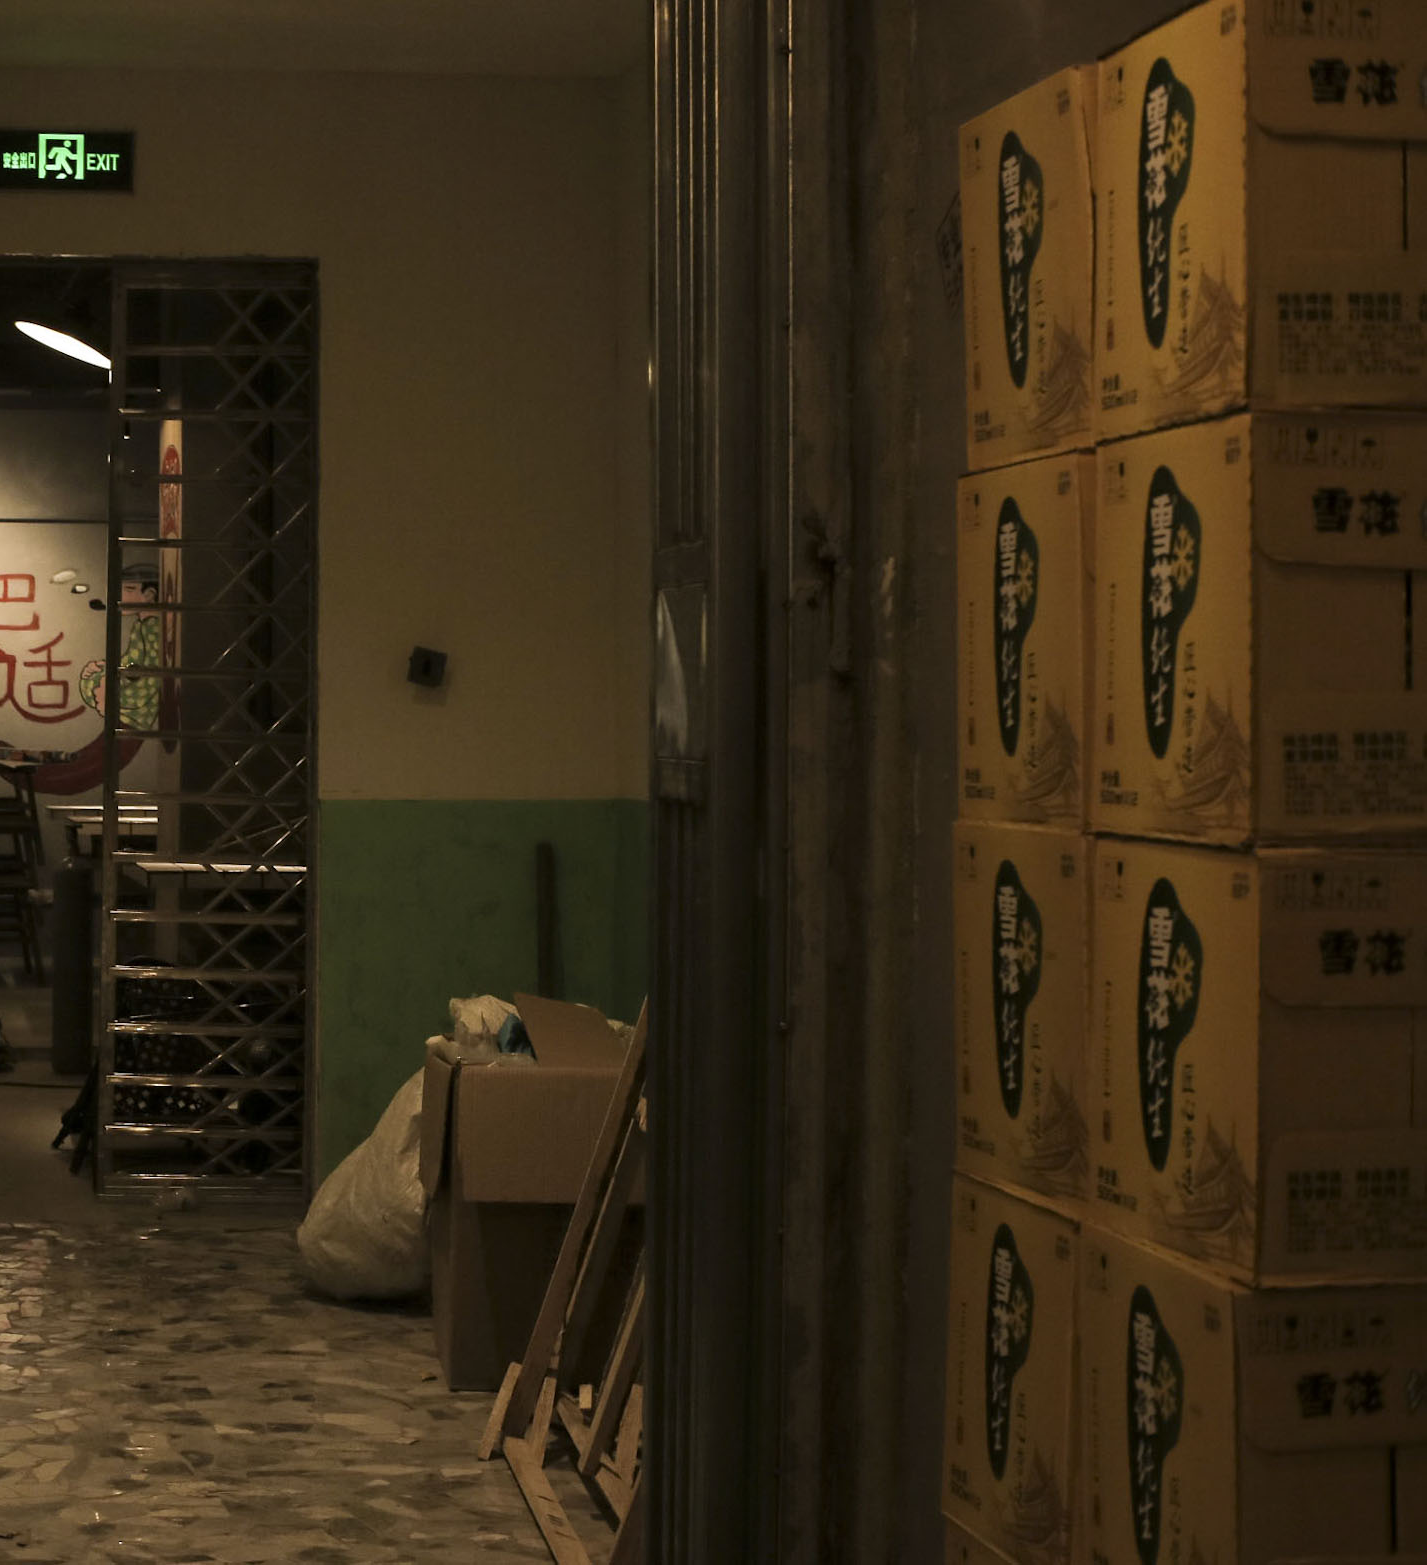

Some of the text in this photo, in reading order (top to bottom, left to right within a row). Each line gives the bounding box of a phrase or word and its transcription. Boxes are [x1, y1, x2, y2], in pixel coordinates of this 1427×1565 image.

[2, 151, 36, 169] 安全出口
[86, 152, 120, 171] EXIT
